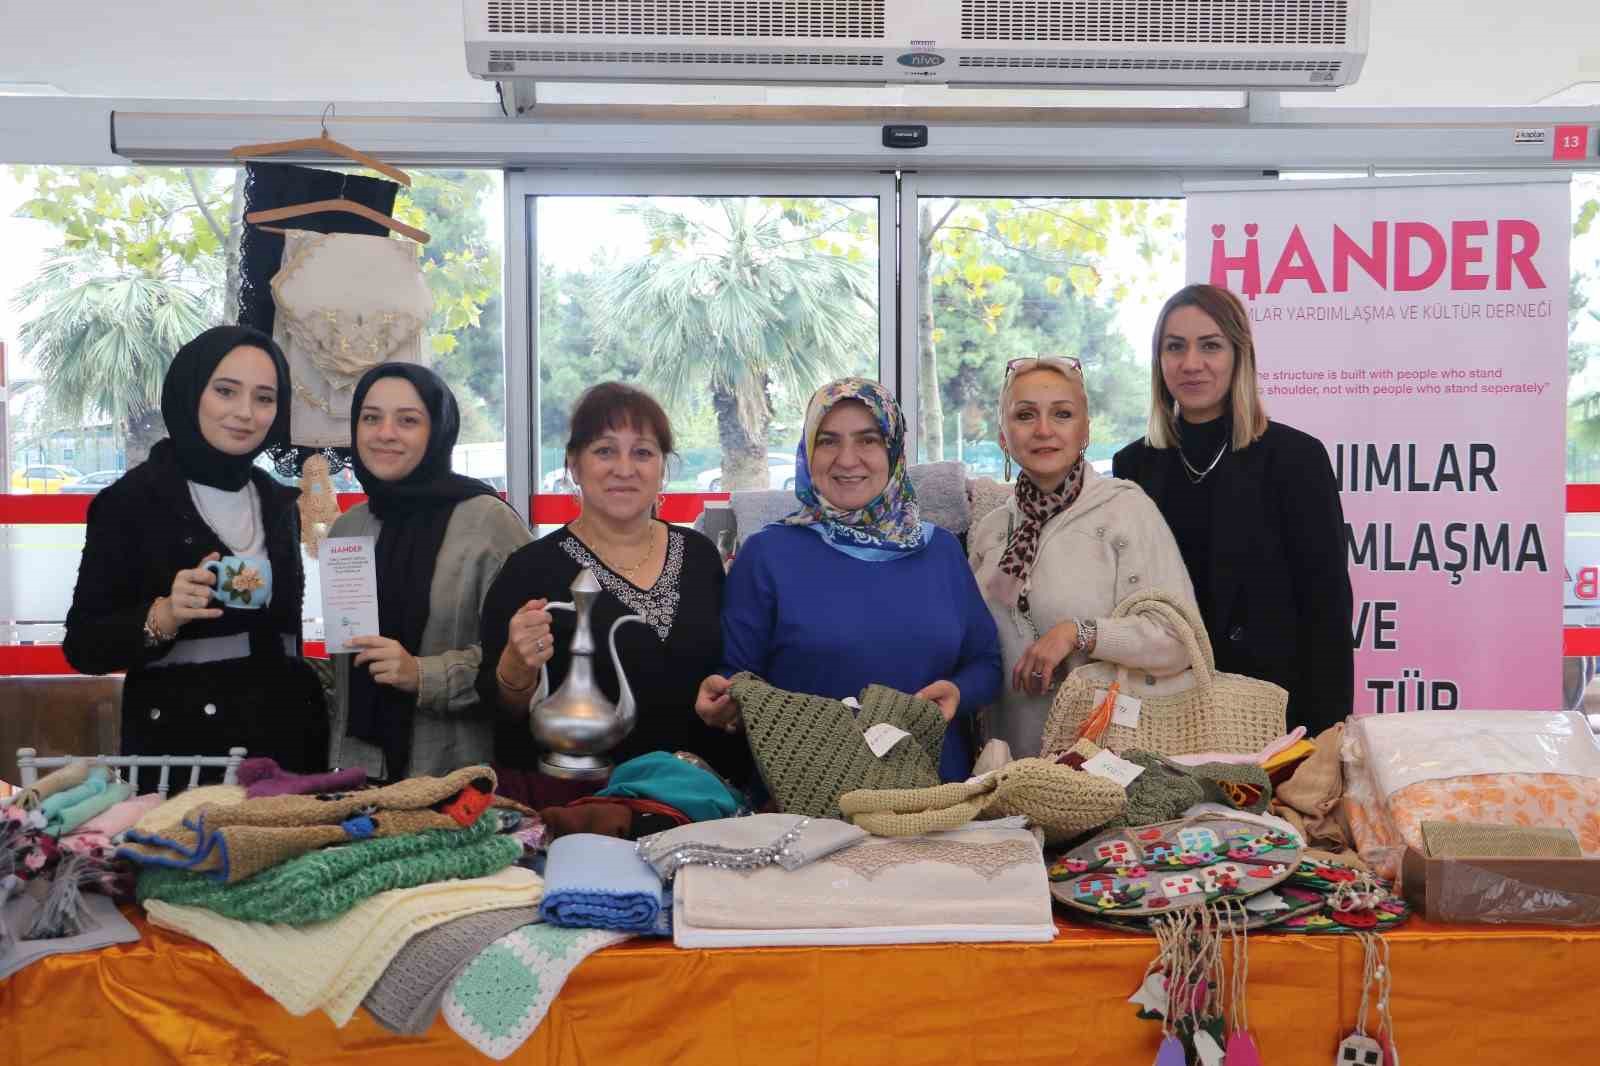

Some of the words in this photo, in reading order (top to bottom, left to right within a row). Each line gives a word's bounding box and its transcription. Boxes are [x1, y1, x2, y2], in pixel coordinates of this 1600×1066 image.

[1563, 136, 1579, 148] 13
[1209, 219, 1546, 300] HANDER
[1286, 306, 1395, 324] YARDIMLAŞMA
[1400, 304, 1417, 319] VE
[1423, 302, 1481, 319] KÜLTÜR
[1486, 300, 1552, 318] DERNEĞİ
[1273, 370, 1324, 380] structure
[1328, 370, 1337, 380] is
[1341, 369, 1366, 380] built
[1369, 369, 1393, 379] with
[1397, 368, 1438, 381] people
[1440, 368, 1466, 379] who
[1469, 367, 1502, 378] stand
[1267, 384, 1319, 396] shoulder,
[1323, 384, 1341, 394] not
[1344, 384, 1369, 394] with
[1373, 383, 1413, 396] people
[1416, 382, 1441, 394] who
[1444, 382, 1477, 393] stand
[1353, 601, 1396, 649] VE
